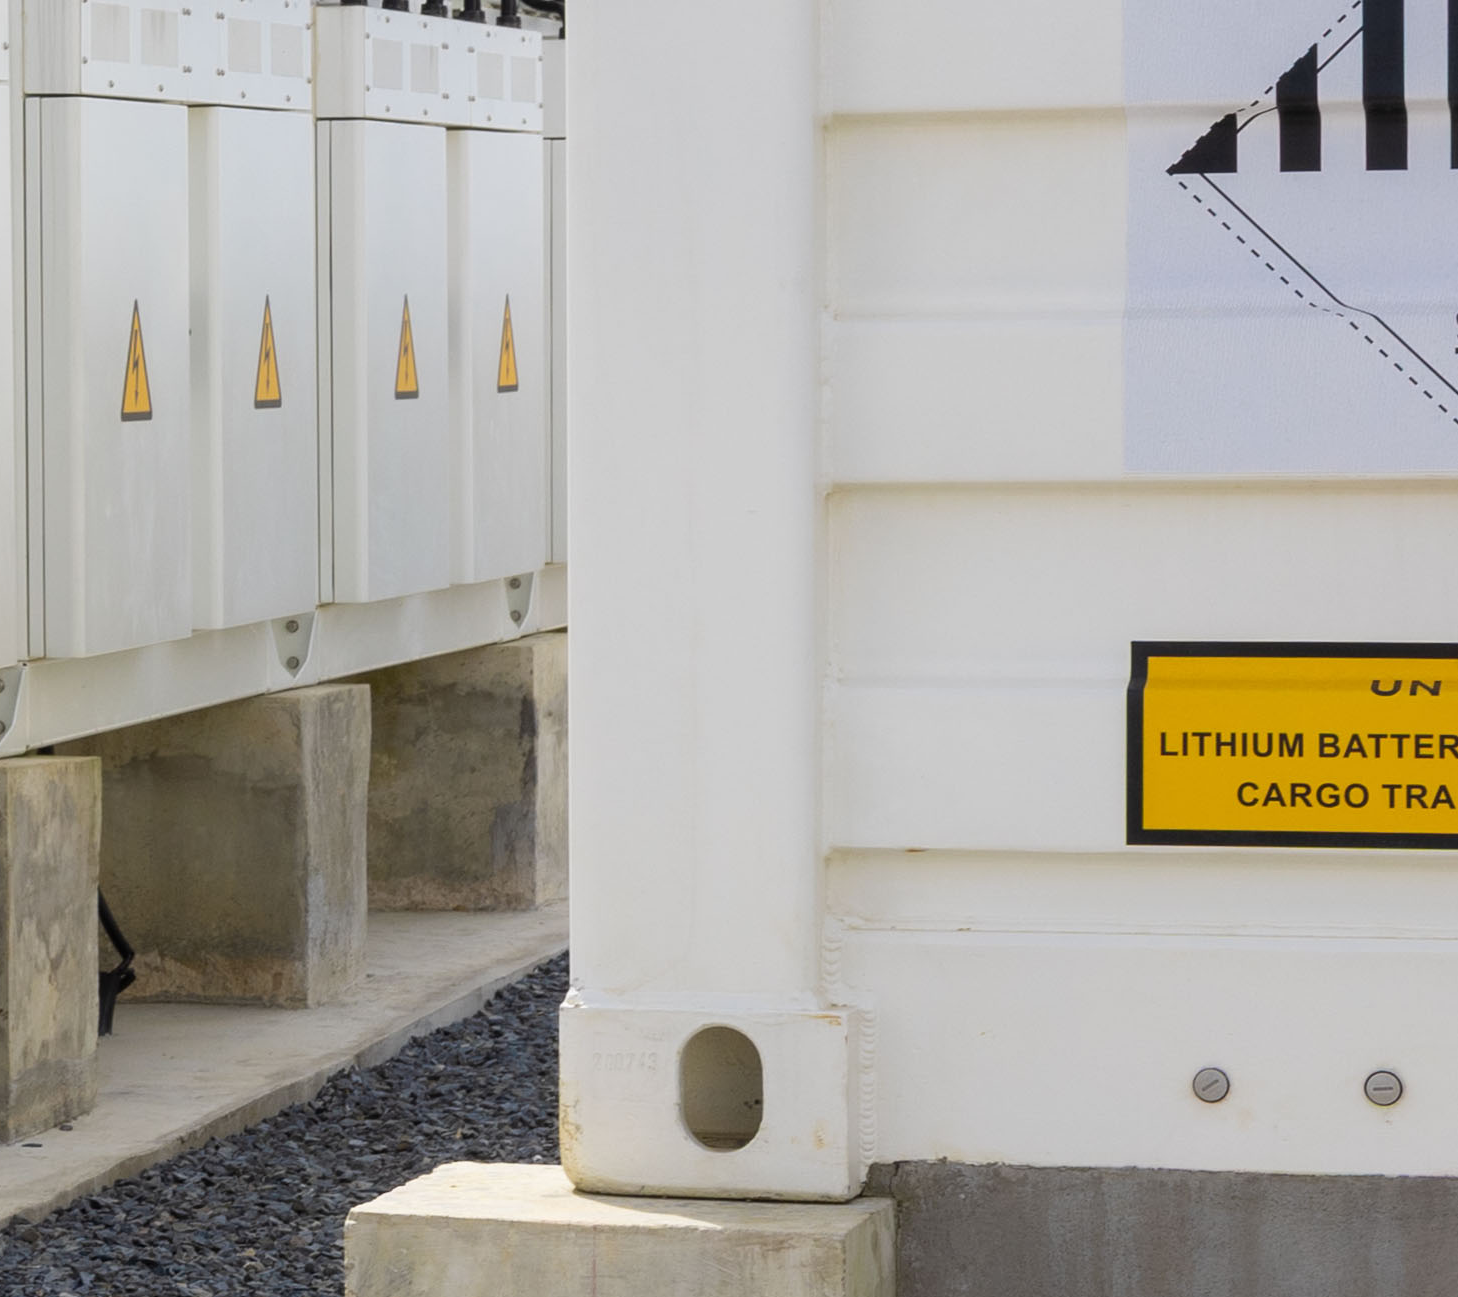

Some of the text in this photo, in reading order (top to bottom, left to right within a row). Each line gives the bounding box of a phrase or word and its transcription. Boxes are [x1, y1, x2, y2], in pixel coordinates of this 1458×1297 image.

[1369, 679, 1443, 697] UN
[1159, 731, 1458, 760] LITHIUM BATTER
[1236, 781, 1457, 810] CARGO TRA
